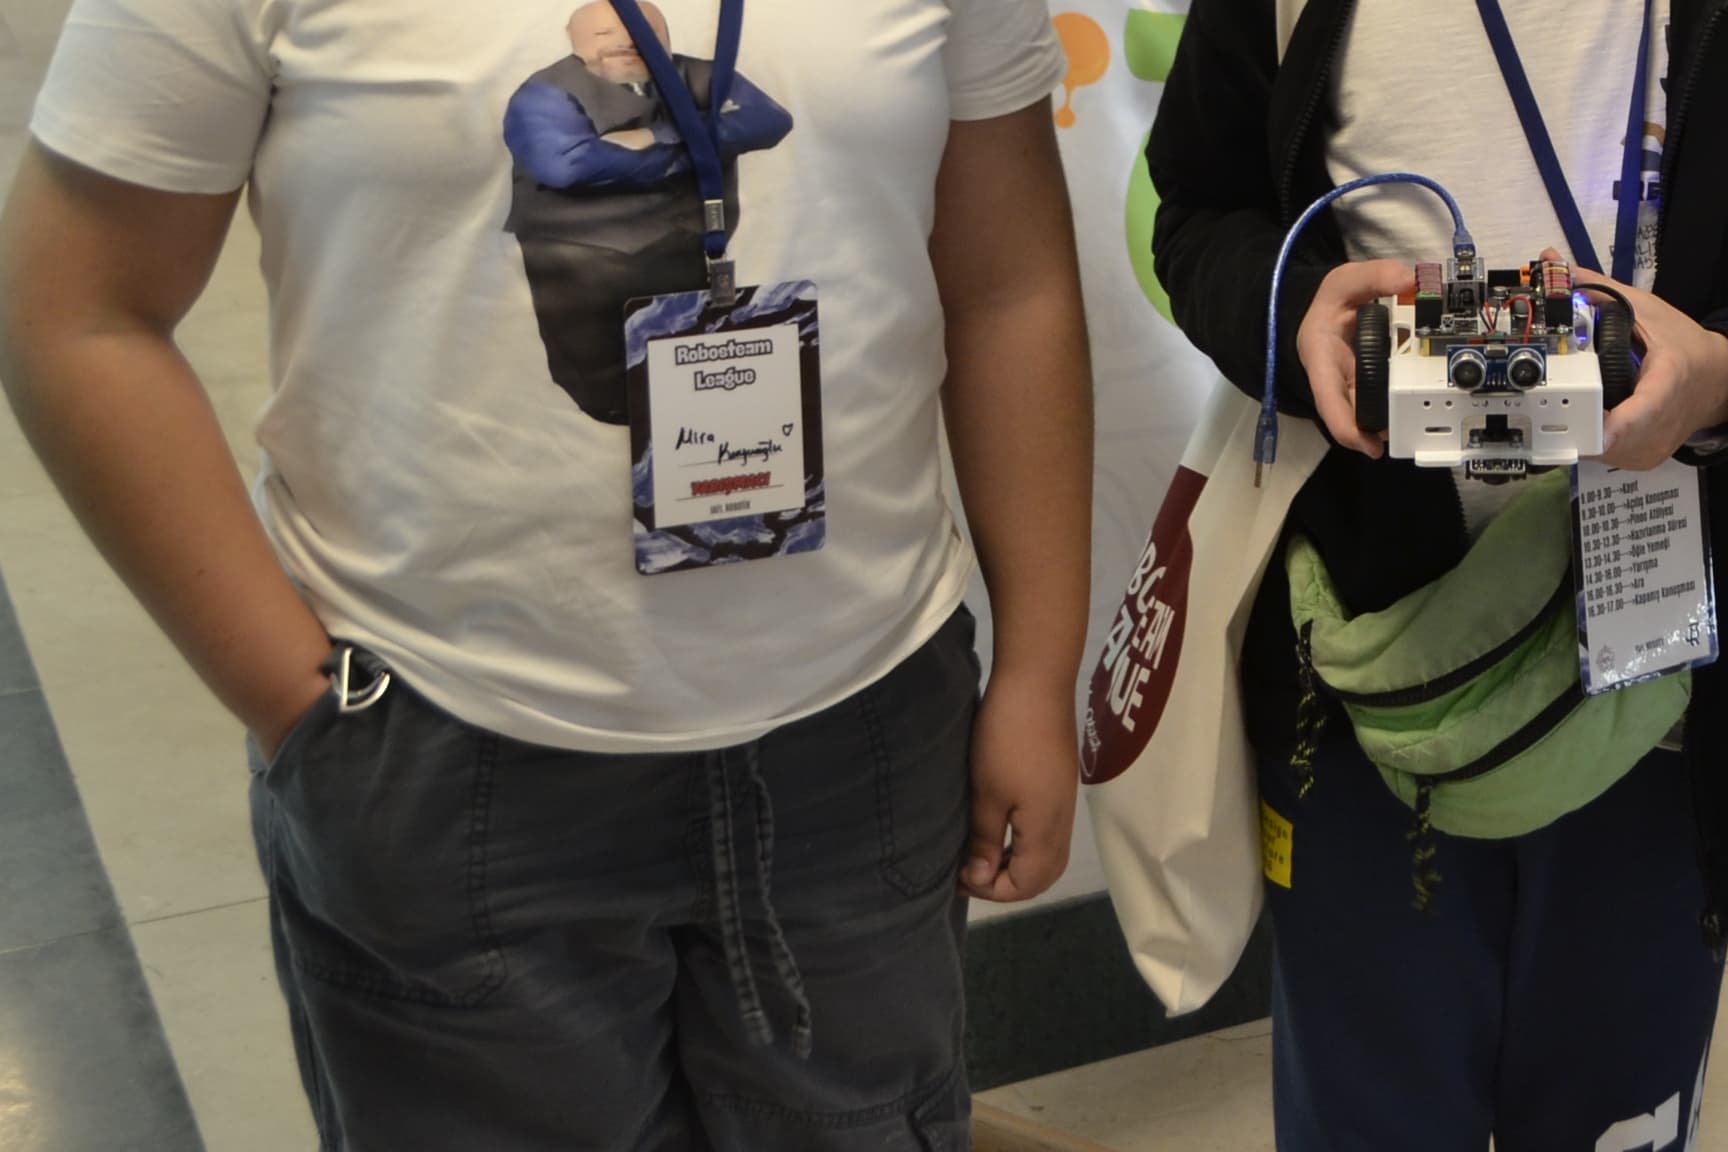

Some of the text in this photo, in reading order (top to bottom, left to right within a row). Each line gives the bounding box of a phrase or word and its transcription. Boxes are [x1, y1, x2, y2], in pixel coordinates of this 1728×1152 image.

[675, 339, 773, 366] Robosteam
[694, 367, 756, 391] League
[675, 427, 715, 450] Mira
